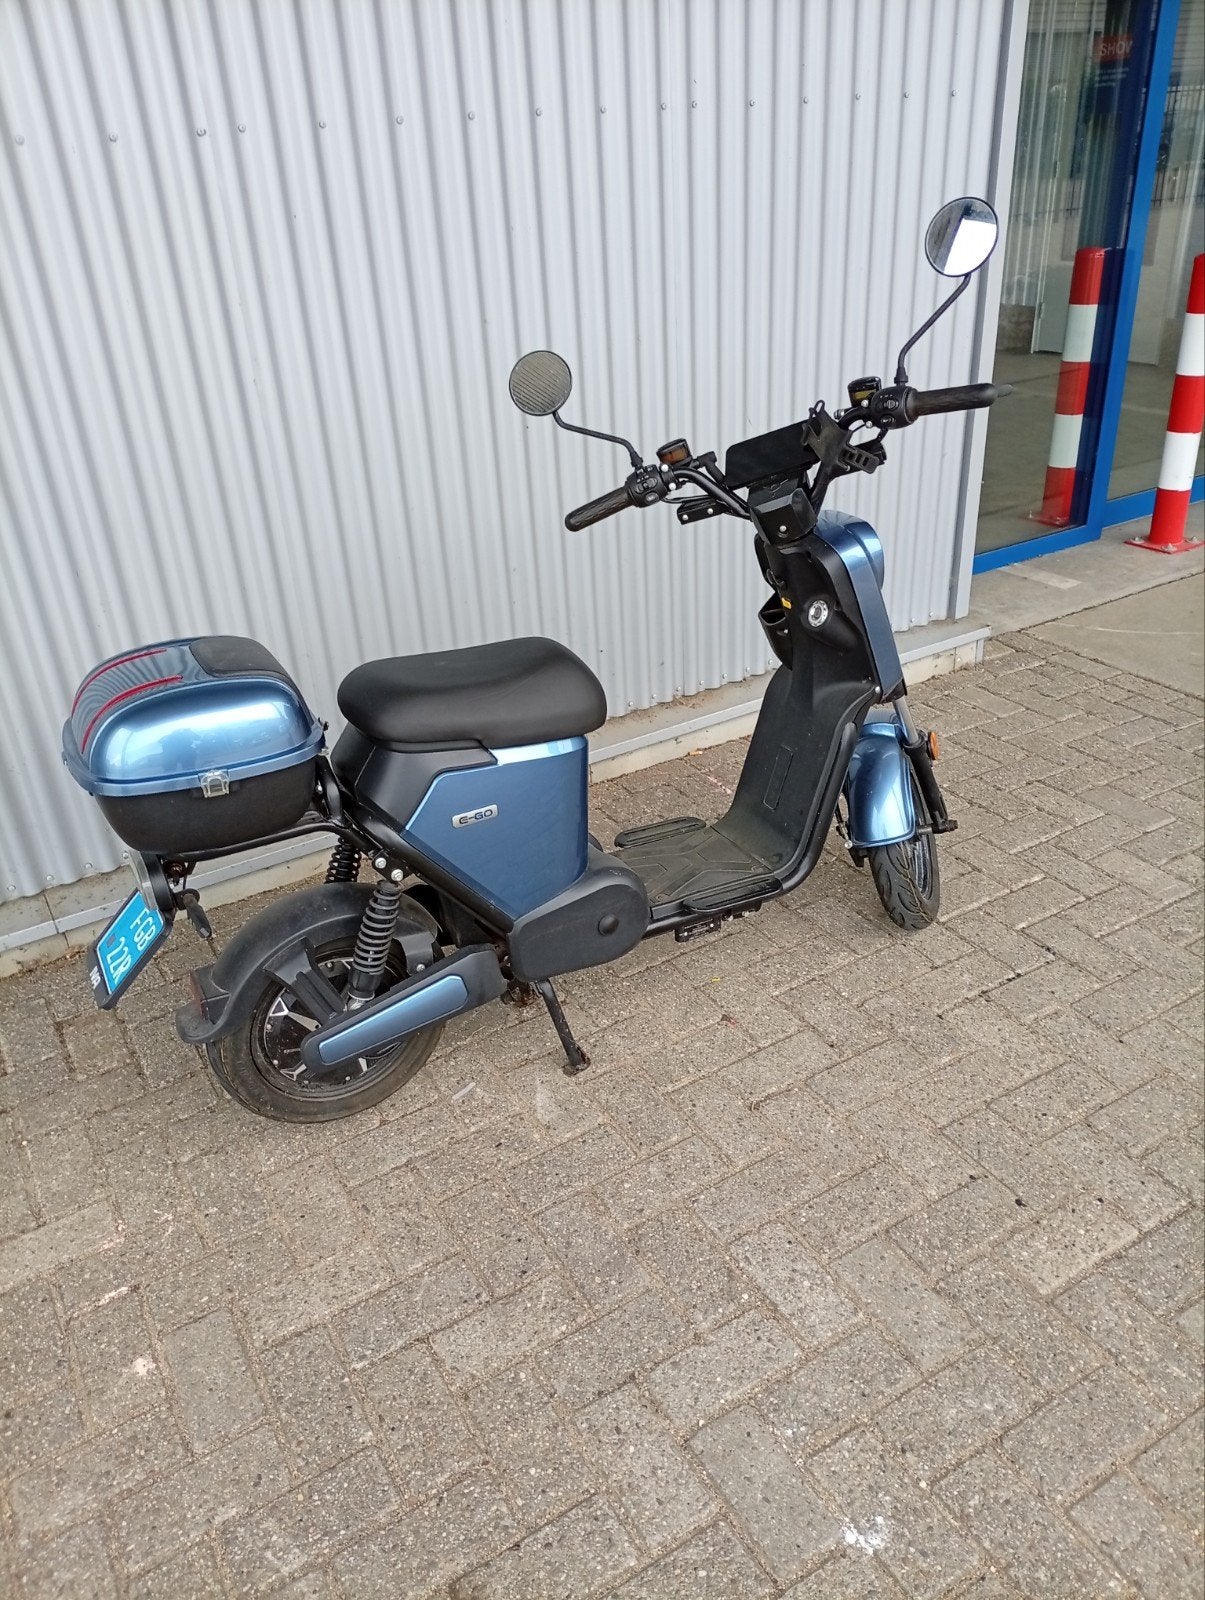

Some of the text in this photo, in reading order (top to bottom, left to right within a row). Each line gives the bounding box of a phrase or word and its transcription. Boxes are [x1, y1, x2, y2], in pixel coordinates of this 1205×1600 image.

[459, 809, 493, 825] E-GO
[130, 907, 157, 952] FGB
[106, 936, 132, 986] 22R
